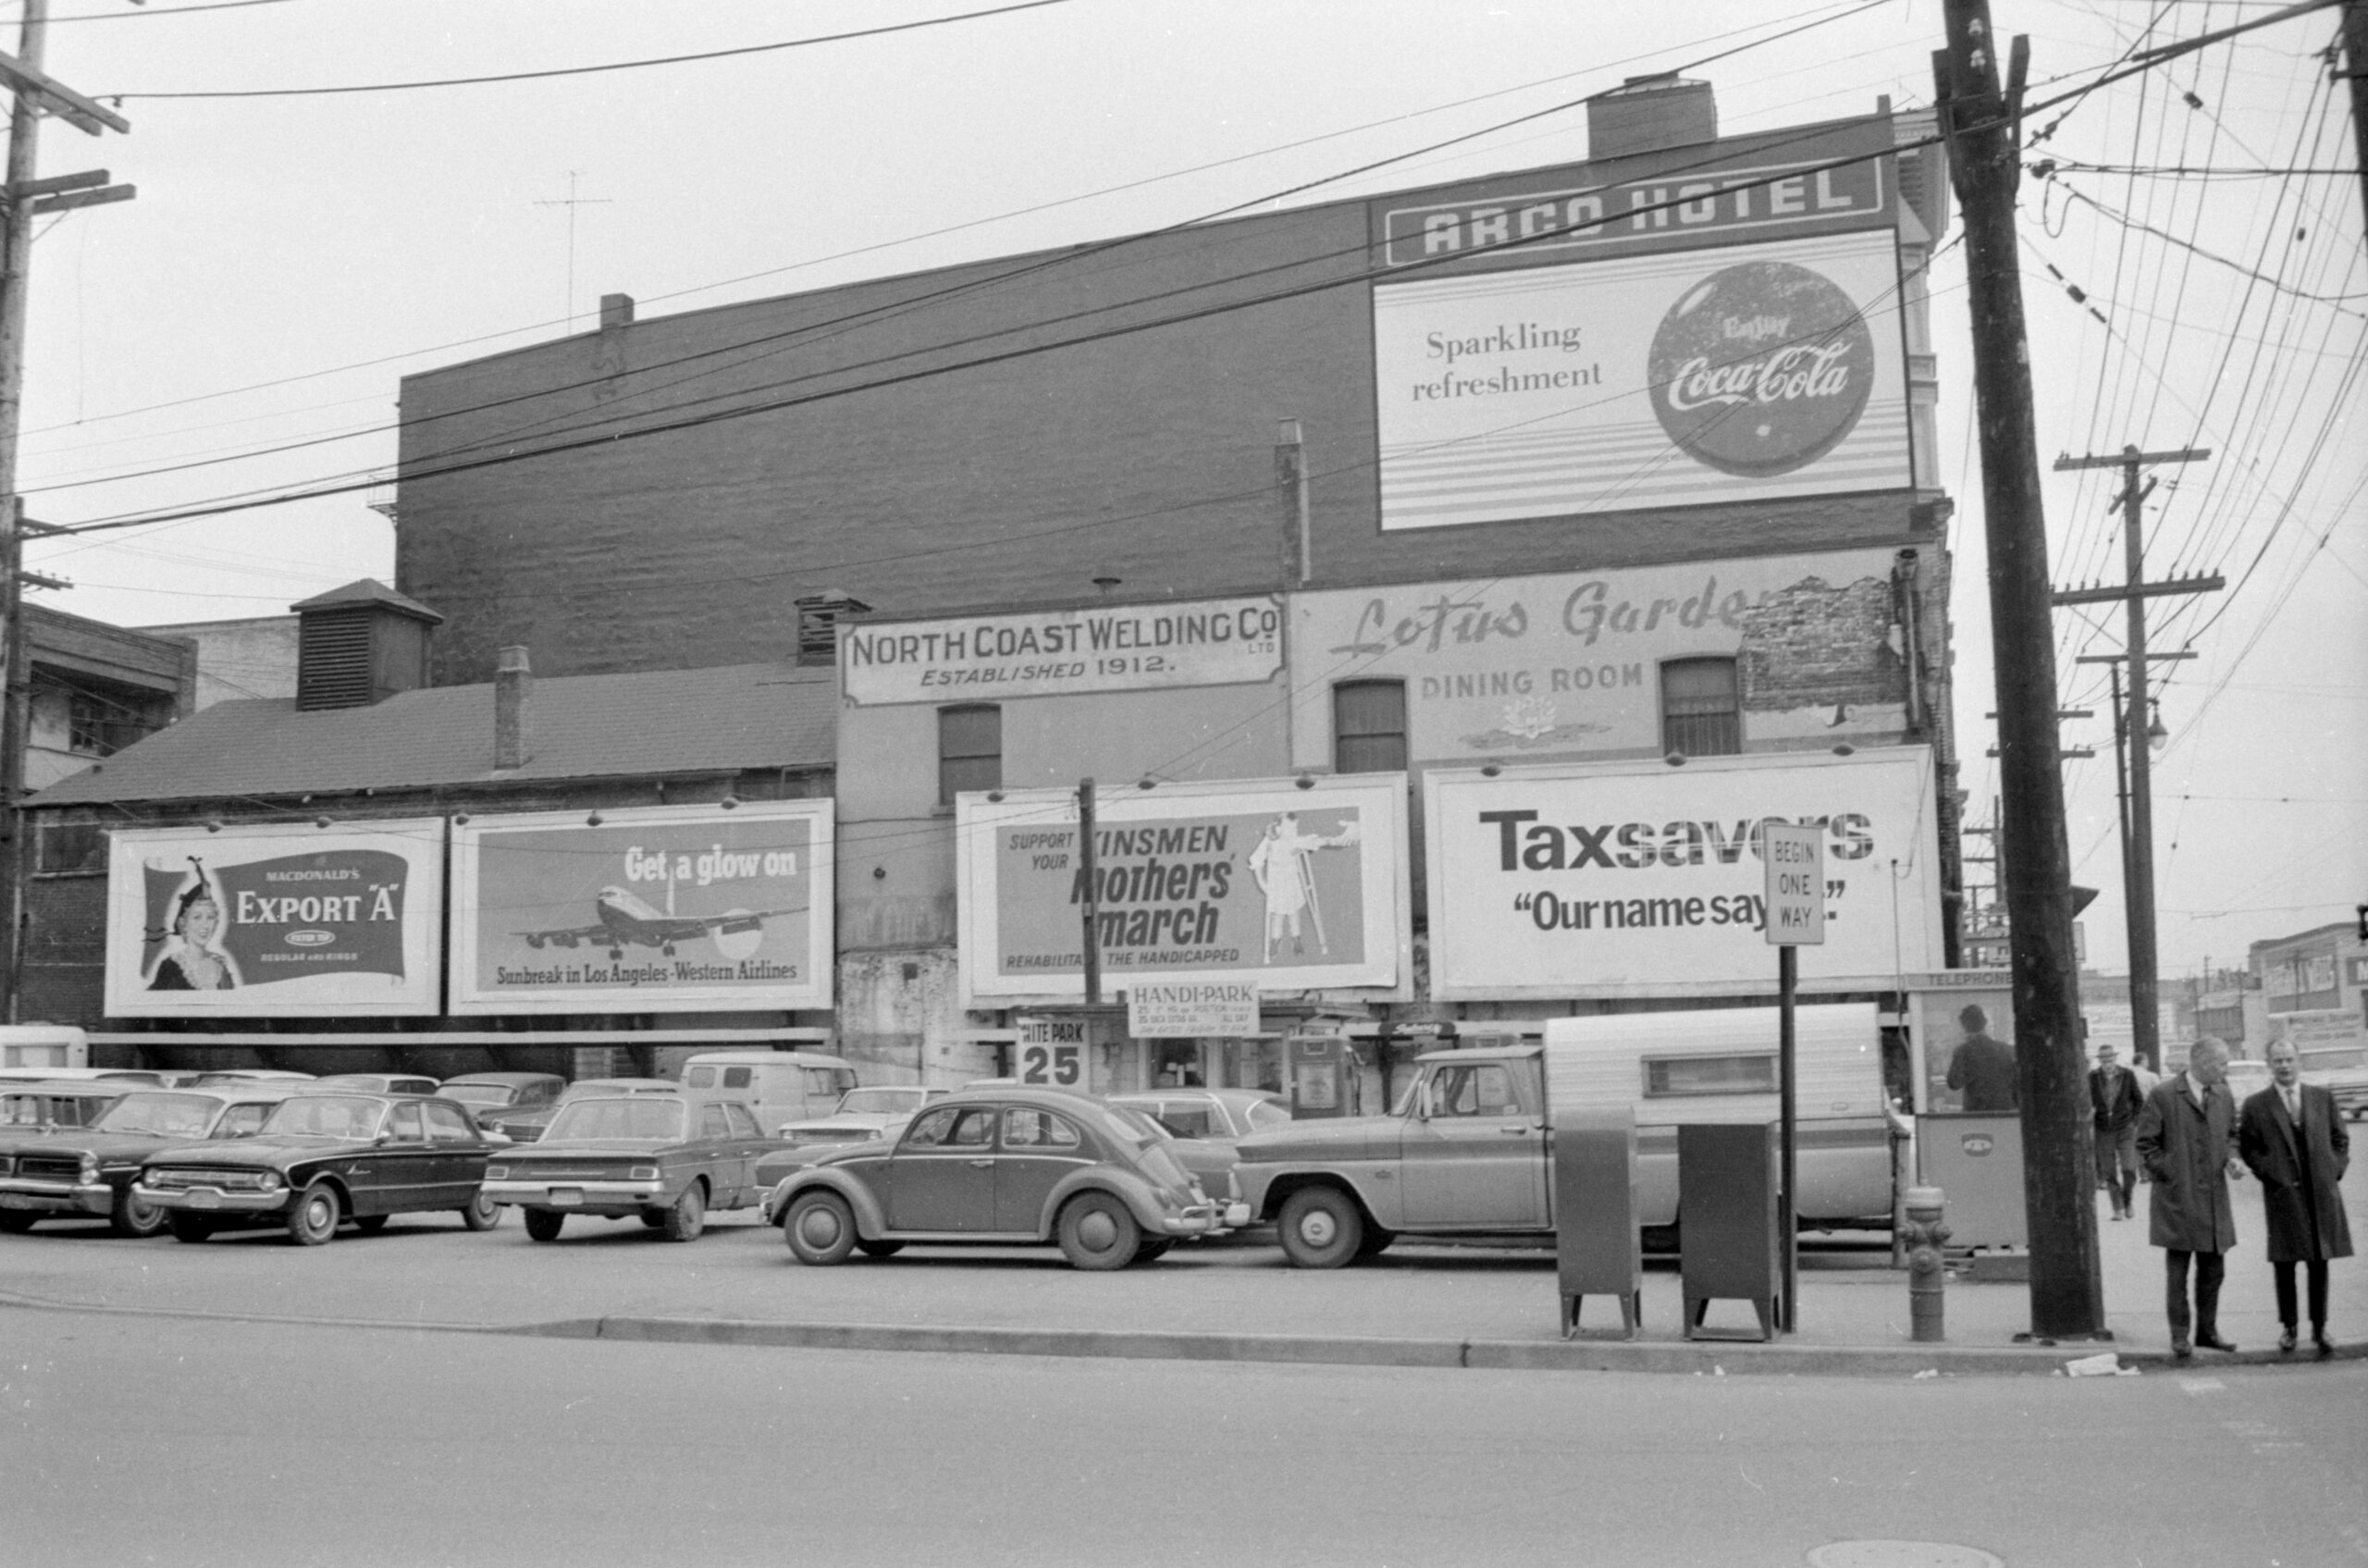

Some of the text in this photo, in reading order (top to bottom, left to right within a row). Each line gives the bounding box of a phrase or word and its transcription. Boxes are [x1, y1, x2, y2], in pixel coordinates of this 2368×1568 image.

[1424, 169, 1853, 254] ARCO HOTEL
[1426, 322, 1582, 364] Sparkling
[1412, 362, 1603, 401] refreshment
[1668, 341, 1852, 412] Coca-Cola
[852, 631, 967, 666] NORTH
[974, 623, 1083, 659] COAST
[1087, 612, 1233, 650] WELDING
[1329, 596, 1529, 659] Lotus
[920, 661, 1085, 686] ESTABLISHED
[1421, 662, 1644, 702] DINING ROOM
[1009, 833, 1074, 849] SUPPORT
[1095, 825, 1228, 857] INSMEN
[1775, 840, 1815, 862] BEGIN
[266, 868, 360, 881] MACDONALD'S
[624, 844, 797, 885] Get a glow on
[1031, 854, 1067, 871] YOUR
[1779, 873, 1811, 895] ONE
[236, 890, 362, 924] EXPORT
[1605, 895, 1705, 929] name
[1780, 906, 1812, 928] WAY
[1097, 900, 1220, 947] march
[497, 963, 563, 984] Sunbreak
[566, 962, 581, 982] in
[584, 962, 609, 982] Los
[739, 959, 797, 980] Airlines
[1006, 947, 1240, 968] REHABILITA THE HANDICAPPED
[1134, 985, 1253, 1004] HANDI-PARK
[1929, 972, 2013, 986] TELEPHONE
[1052, 1022, 1084, 1043] PARK
[1024, 1046, 1079, 1086] 25
